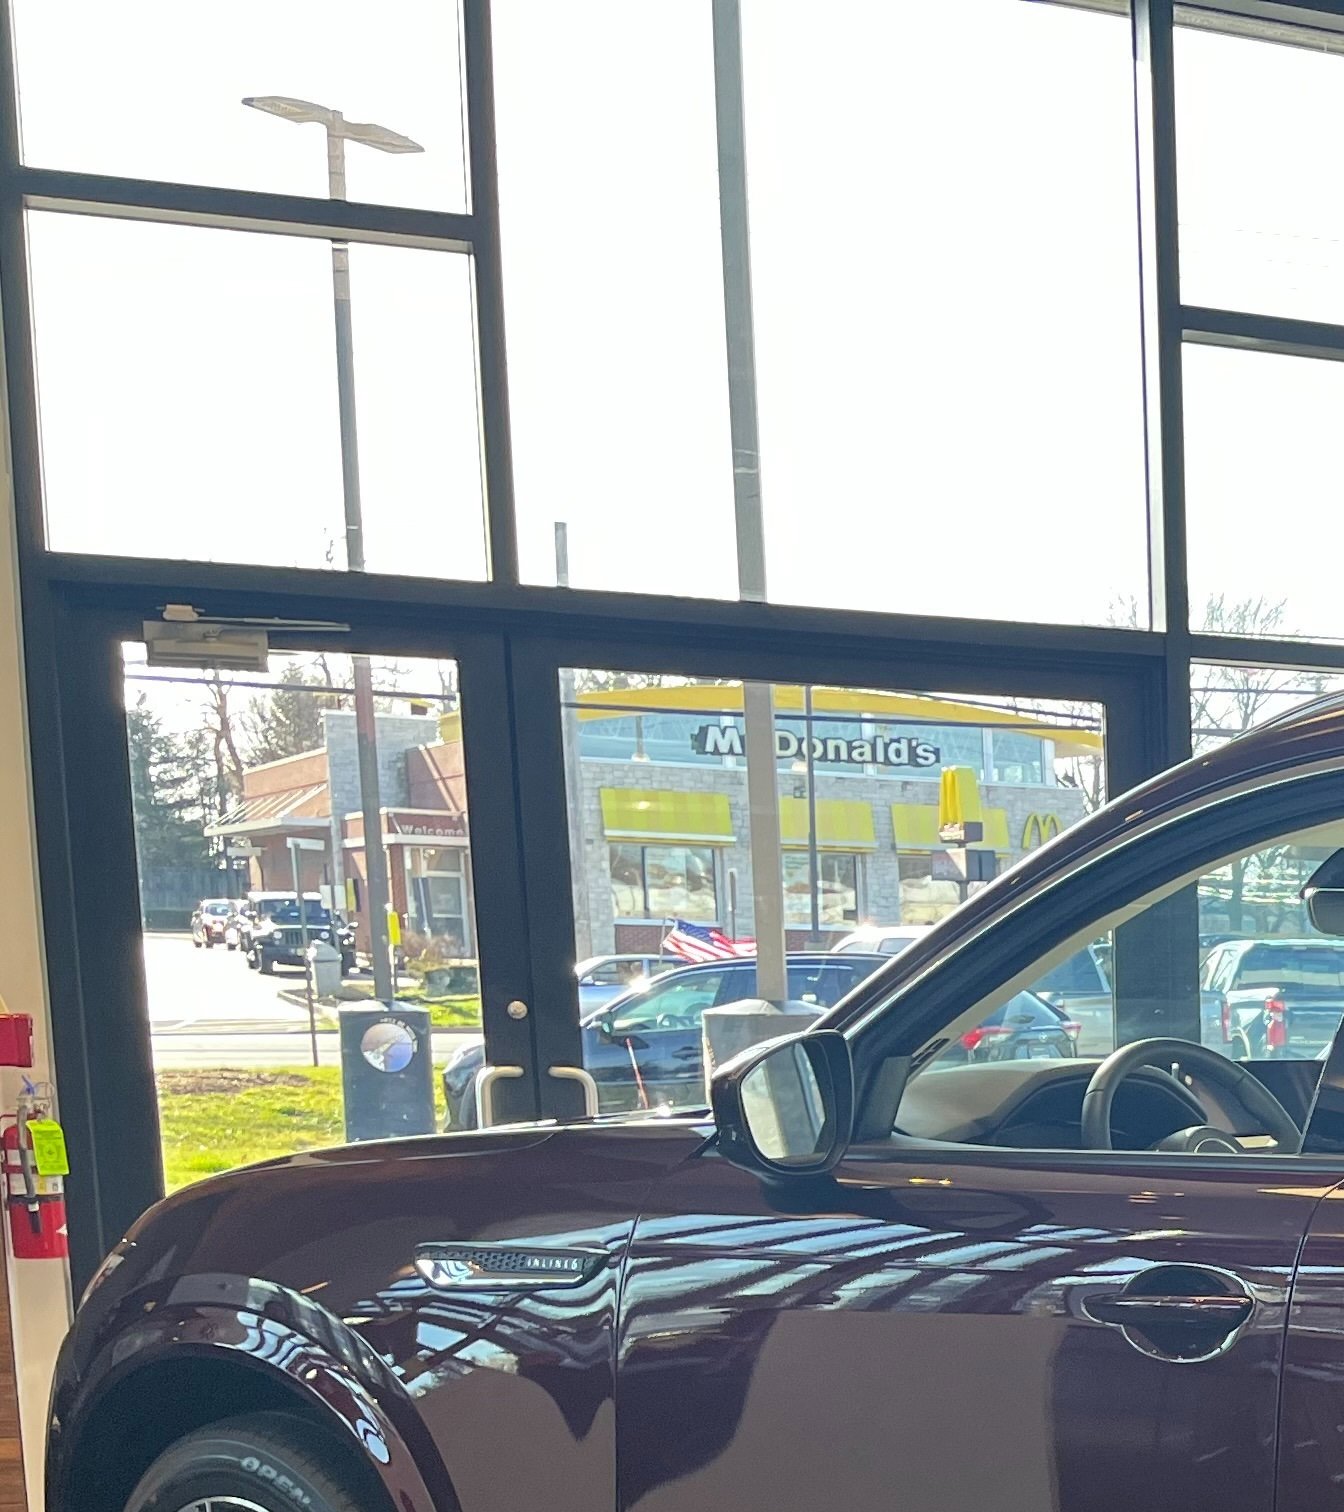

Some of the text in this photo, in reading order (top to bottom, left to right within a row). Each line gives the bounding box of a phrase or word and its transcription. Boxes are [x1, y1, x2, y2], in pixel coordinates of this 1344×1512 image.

[704, 724, 938, 767] MDonald's
[401, 824, 465, 837] Welcome
[239, 1456, 312, 1505] OPEN
